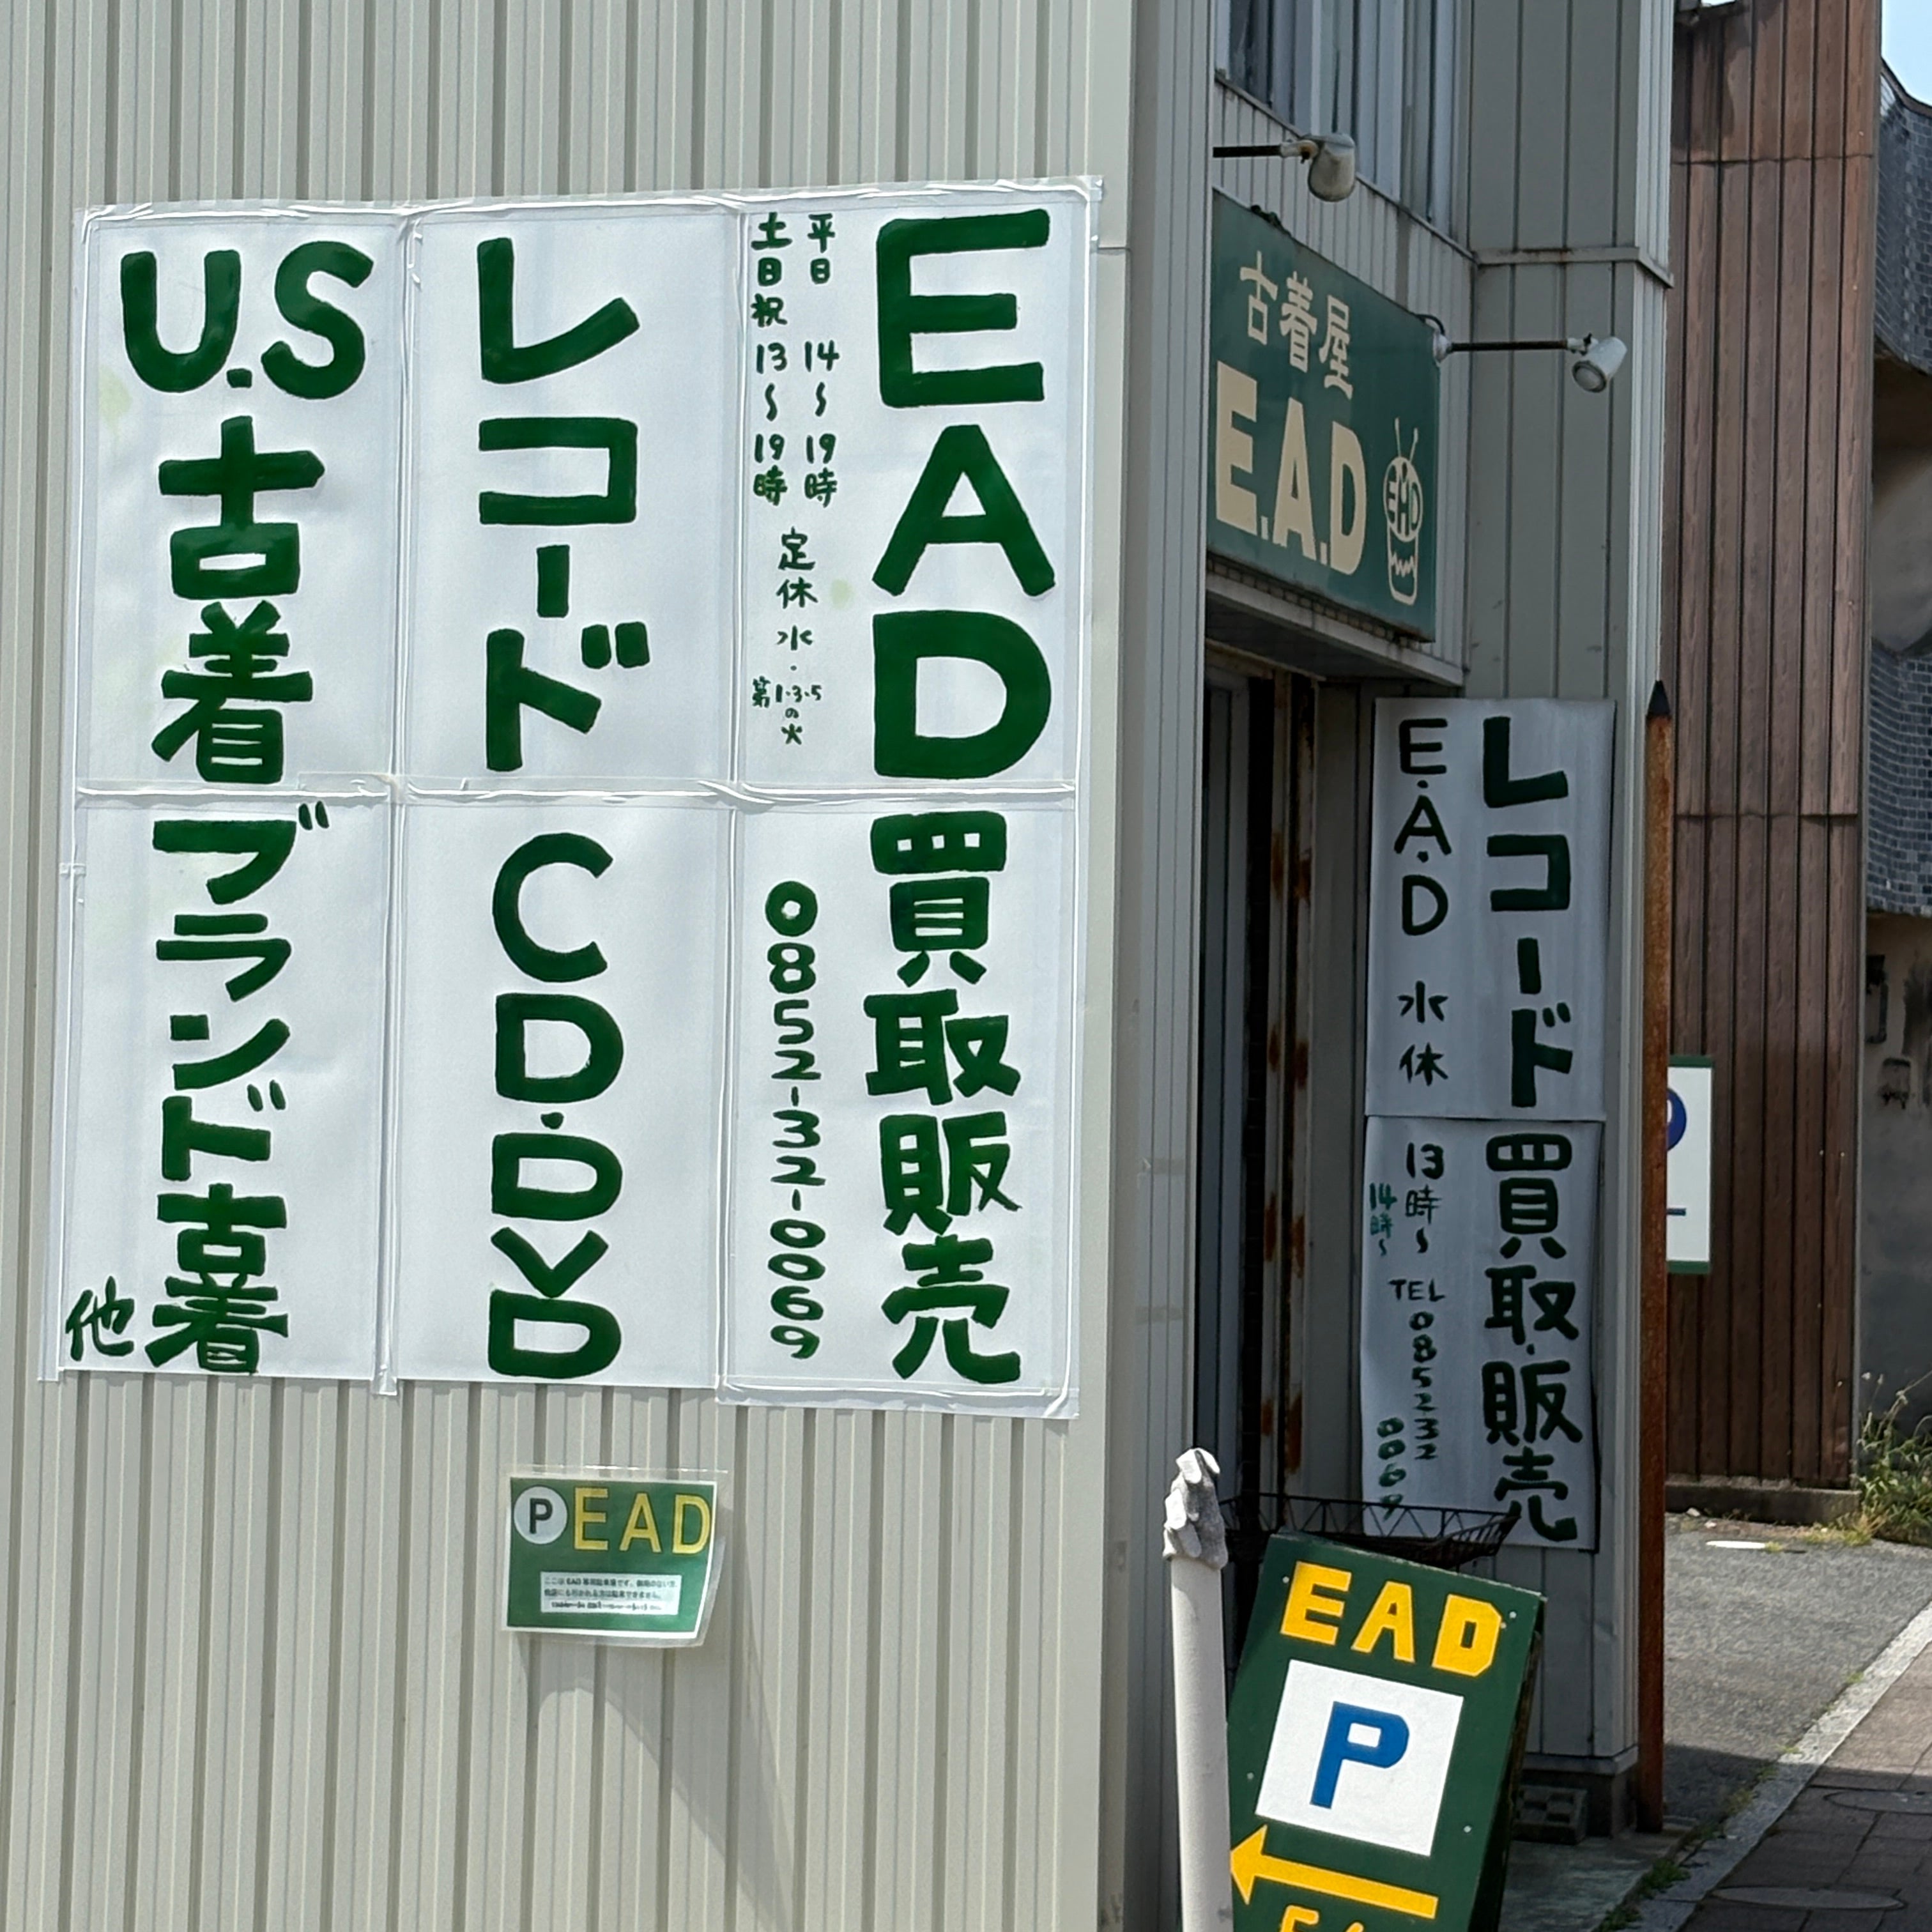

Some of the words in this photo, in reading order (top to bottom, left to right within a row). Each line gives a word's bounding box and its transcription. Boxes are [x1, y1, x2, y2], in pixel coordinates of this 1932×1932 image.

[1240, 250, 1353, 400] 古着屋
[477, 238, 650, 772] レコード
[1216, 360, 1367, 575] E.A.D
[1483, 717, 1573, 1108] レコード
[765, 881, 825, 1359] 0852-32-0069
[65, 1276, 134, 1361] 他
[1388, 1280, 1445, 1302] TEL
[574, 1487, 711, 1554] EAD
[1280, 1561, 1502, 1677] EAD
[1310, 1700, 1410, 1809] P
